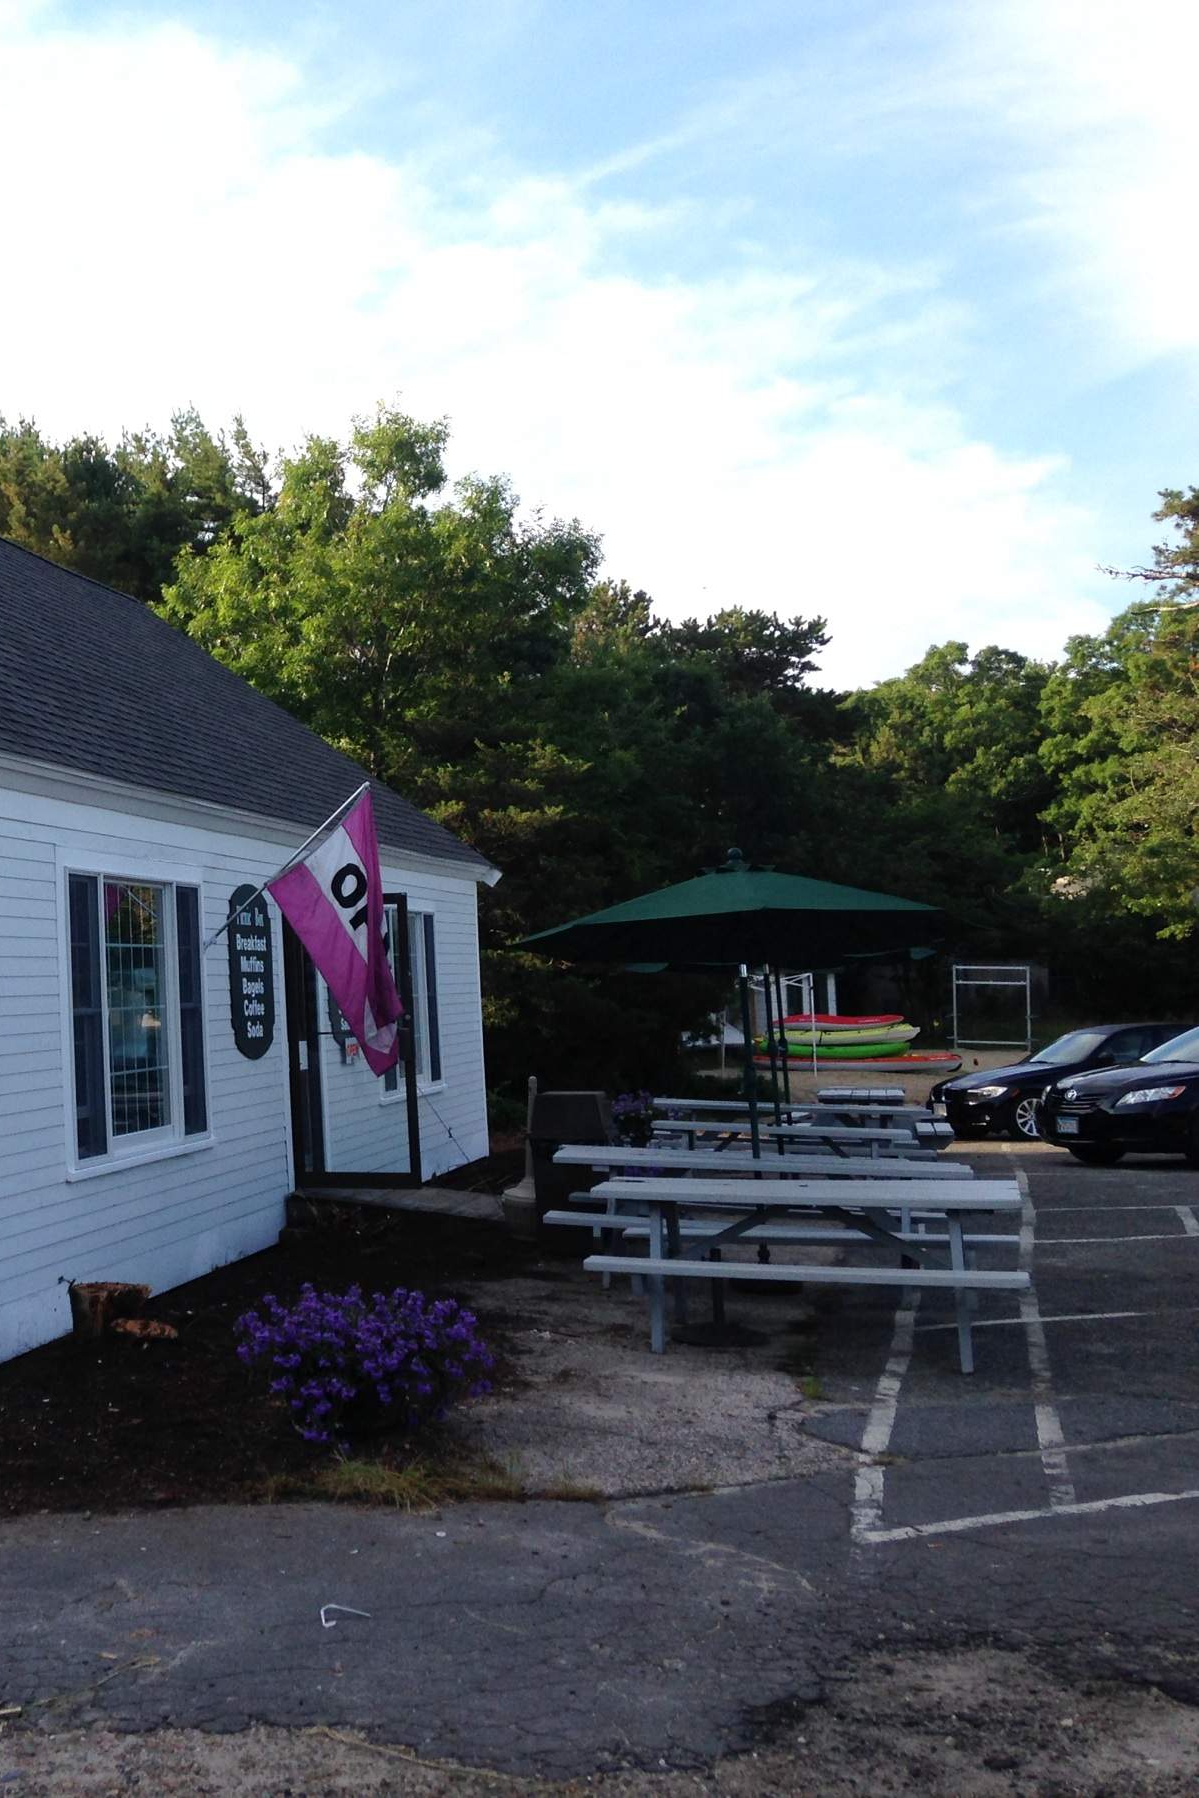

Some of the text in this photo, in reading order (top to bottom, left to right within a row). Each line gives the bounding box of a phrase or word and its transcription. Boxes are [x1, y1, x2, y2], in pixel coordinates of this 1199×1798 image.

[236, 933, 267, 951] Breakfast
[240, 955, 265, 973] Muffins
[242, 977, 265, 997] Bagels
[243, 999, 266, 1016] Coffee
[247, 1020, 264, 1039] Soda
